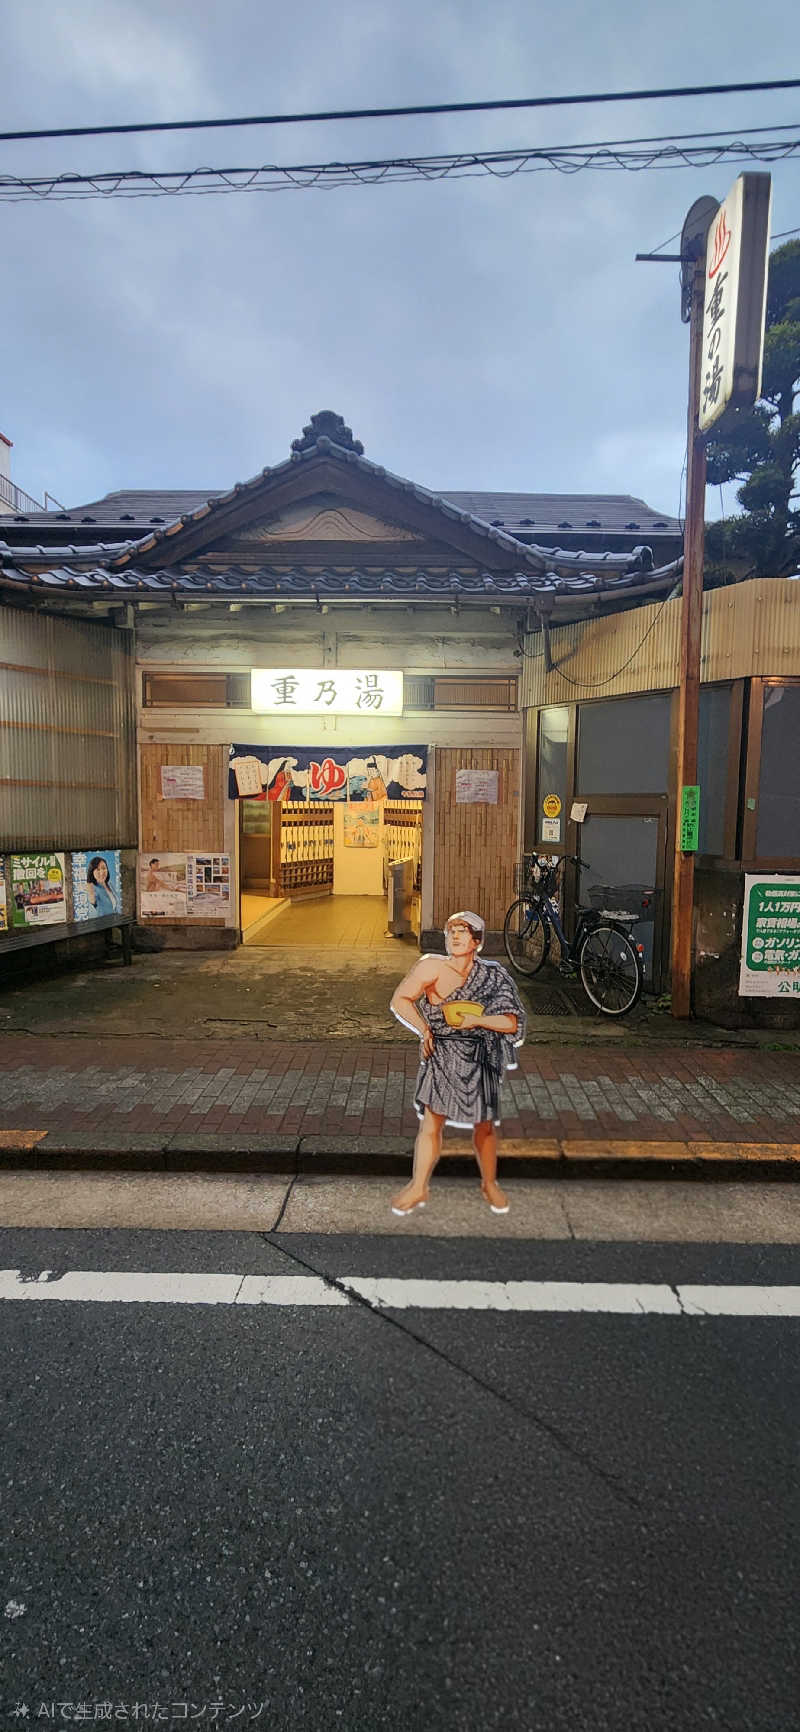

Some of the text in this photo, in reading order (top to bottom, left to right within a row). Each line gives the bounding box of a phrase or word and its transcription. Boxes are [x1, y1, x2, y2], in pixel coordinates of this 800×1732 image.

[703, 271, 728, 414] 重の湯
[271, 674, 385, 710] 重乃湯
[309, 758, 345, 797] ゆ
